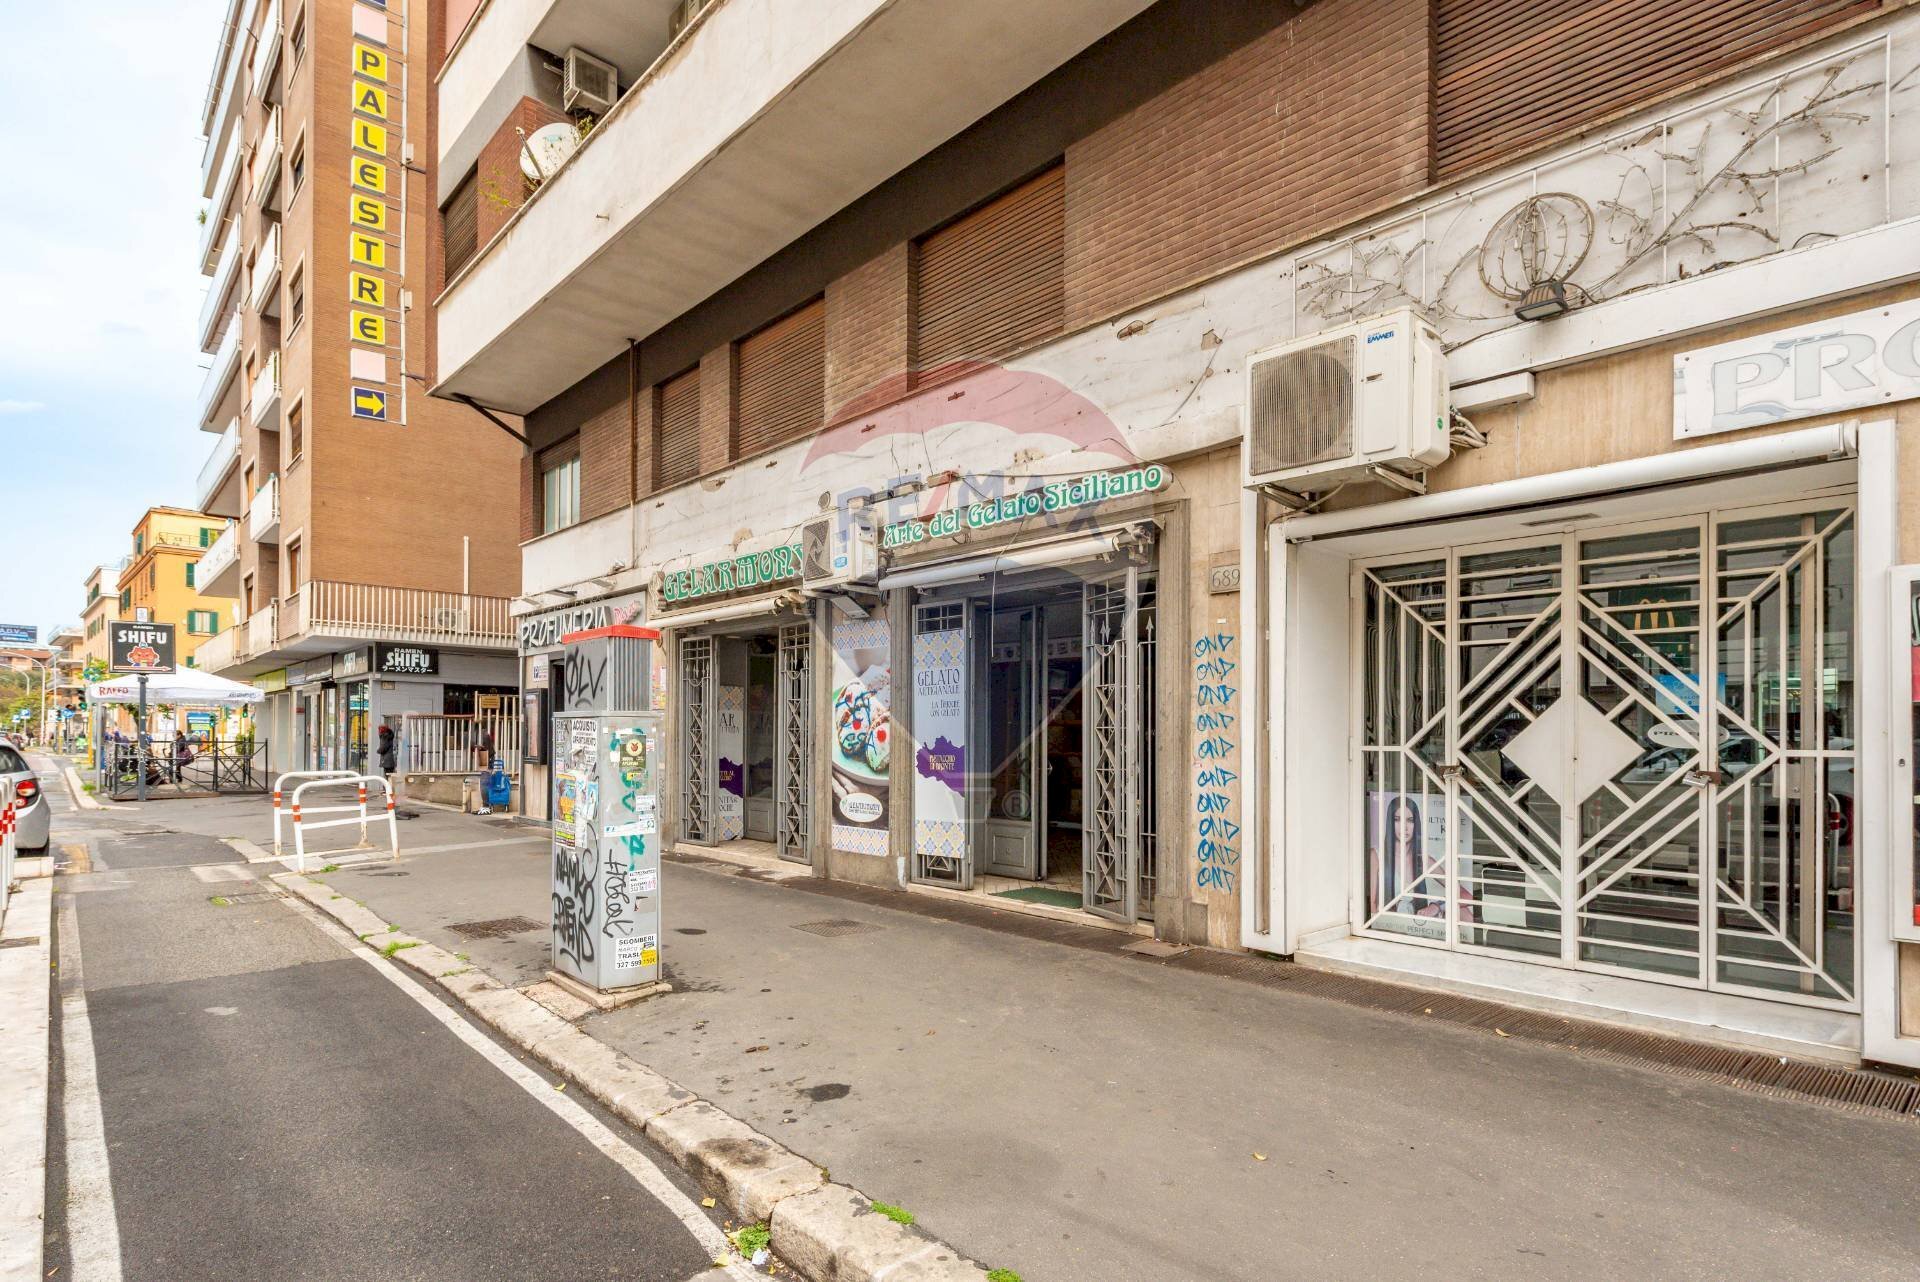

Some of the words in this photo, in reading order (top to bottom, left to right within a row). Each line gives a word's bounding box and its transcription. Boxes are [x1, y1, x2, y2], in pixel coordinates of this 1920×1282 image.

[358, 49, 382, 341] PALESTRE
[883, 520, 923, 548] Arte
[930, 510, 961, 536] del
[968, 492, 1040, 529] Gelato
[1043, 464, 1164, 512] Siciliano
[1212, 569, 1240, 588] 689
[521, 605, 609, 649] PROFUMERIA
[117, 629, 167, 645] SHIFU
[385, 652, 430, 668] SHIFU
[918, 668, 960, 687] GELATO
[618, 935, 654, 946] SGOMBERI
